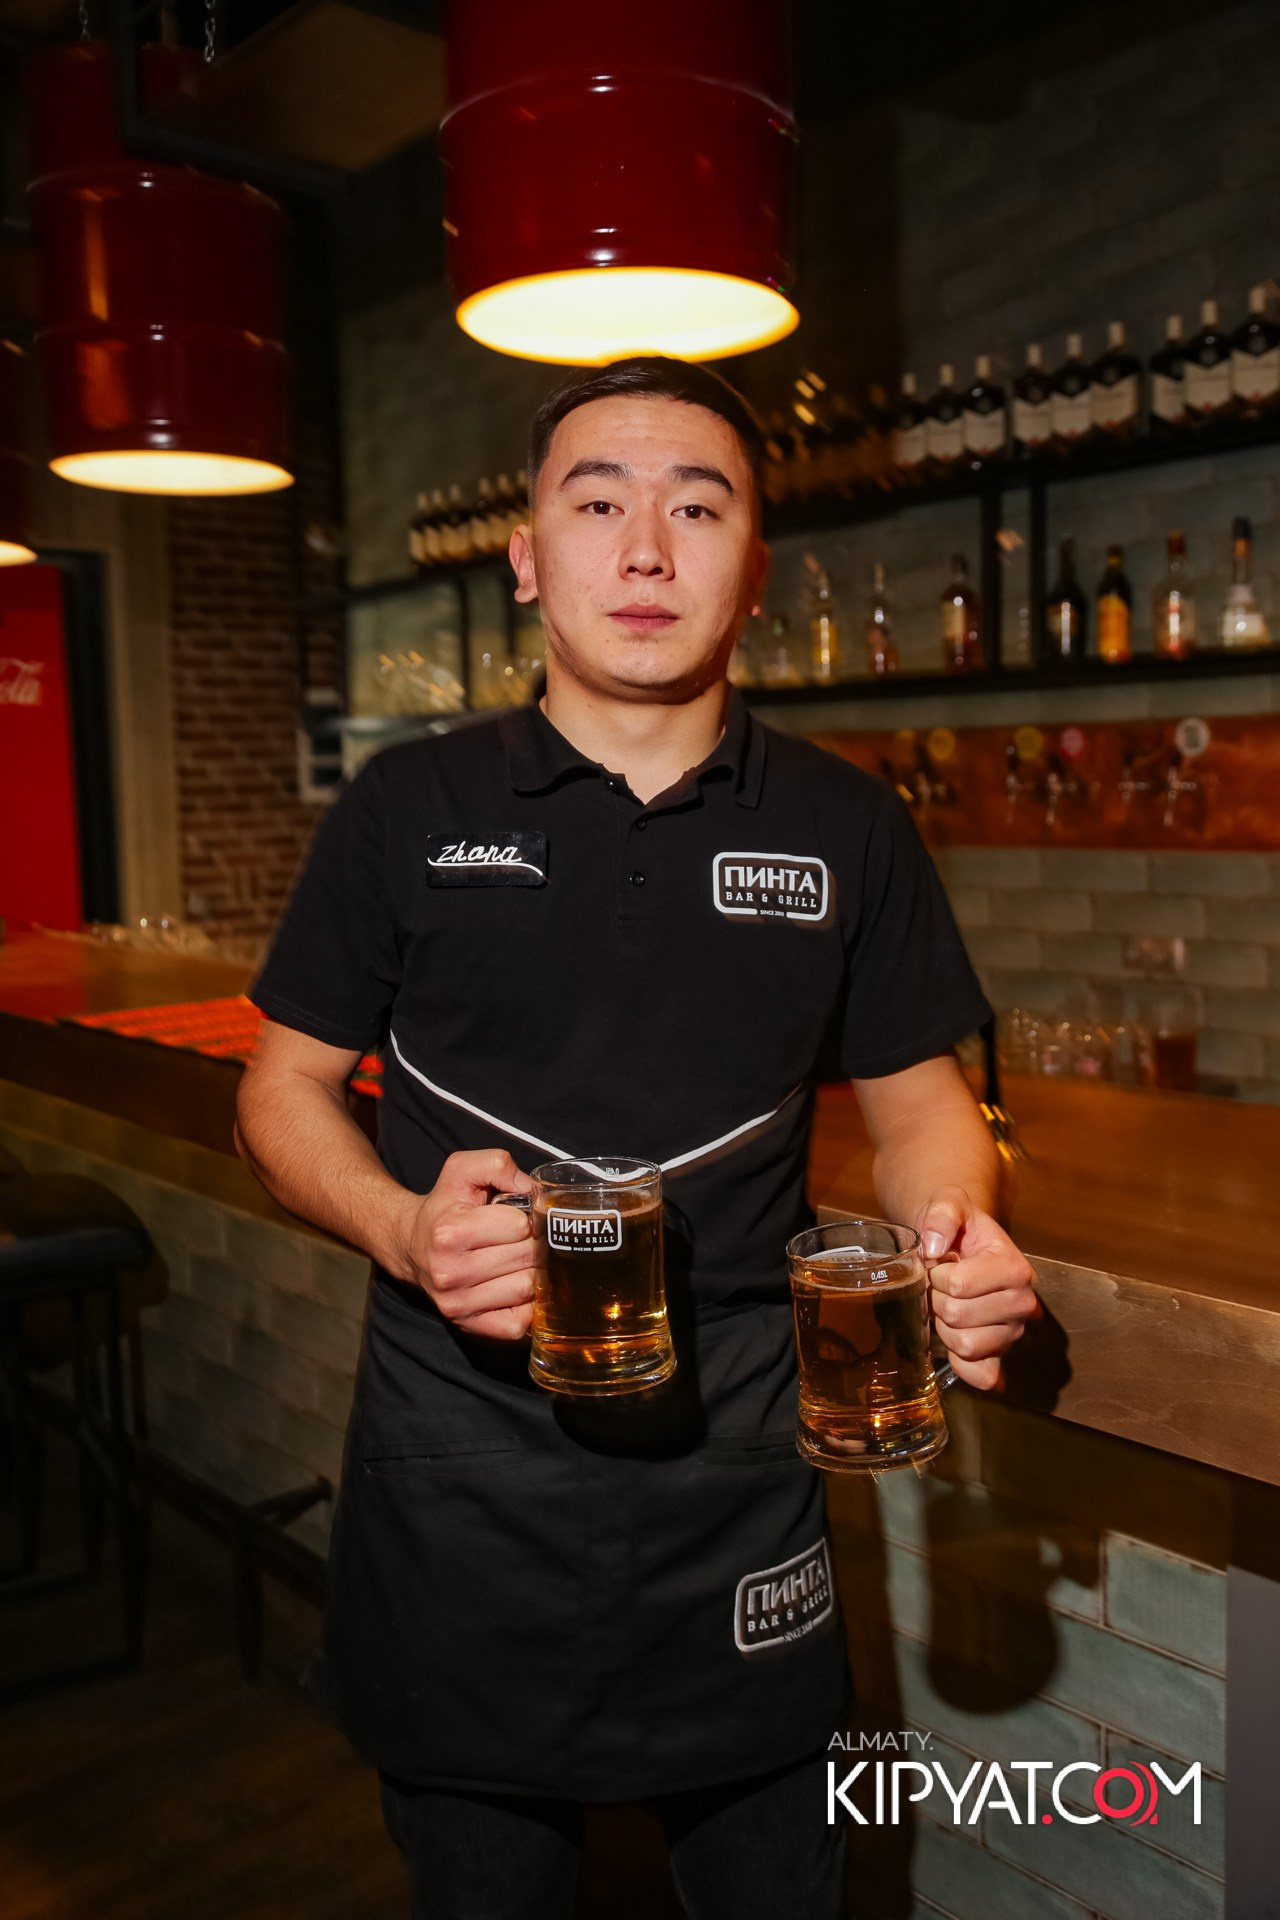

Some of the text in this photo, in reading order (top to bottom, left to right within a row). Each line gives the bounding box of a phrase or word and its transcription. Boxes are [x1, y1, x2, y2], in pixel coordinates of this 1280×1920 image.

[725, 866, 816, 893] ПИНТА
[726, 892, 816, 907] BAR & GRILL
[553, 1217, 614, 1234] ПИНТА
[554, 1234, 569, 1243] BAR
[585, 1236, 615, 1244] GRILL
[746, 1556, 826, 1614] ПИНТА
[748, 1615, 779, 1632] BAR
[787, 1609, 794, 1620] &
